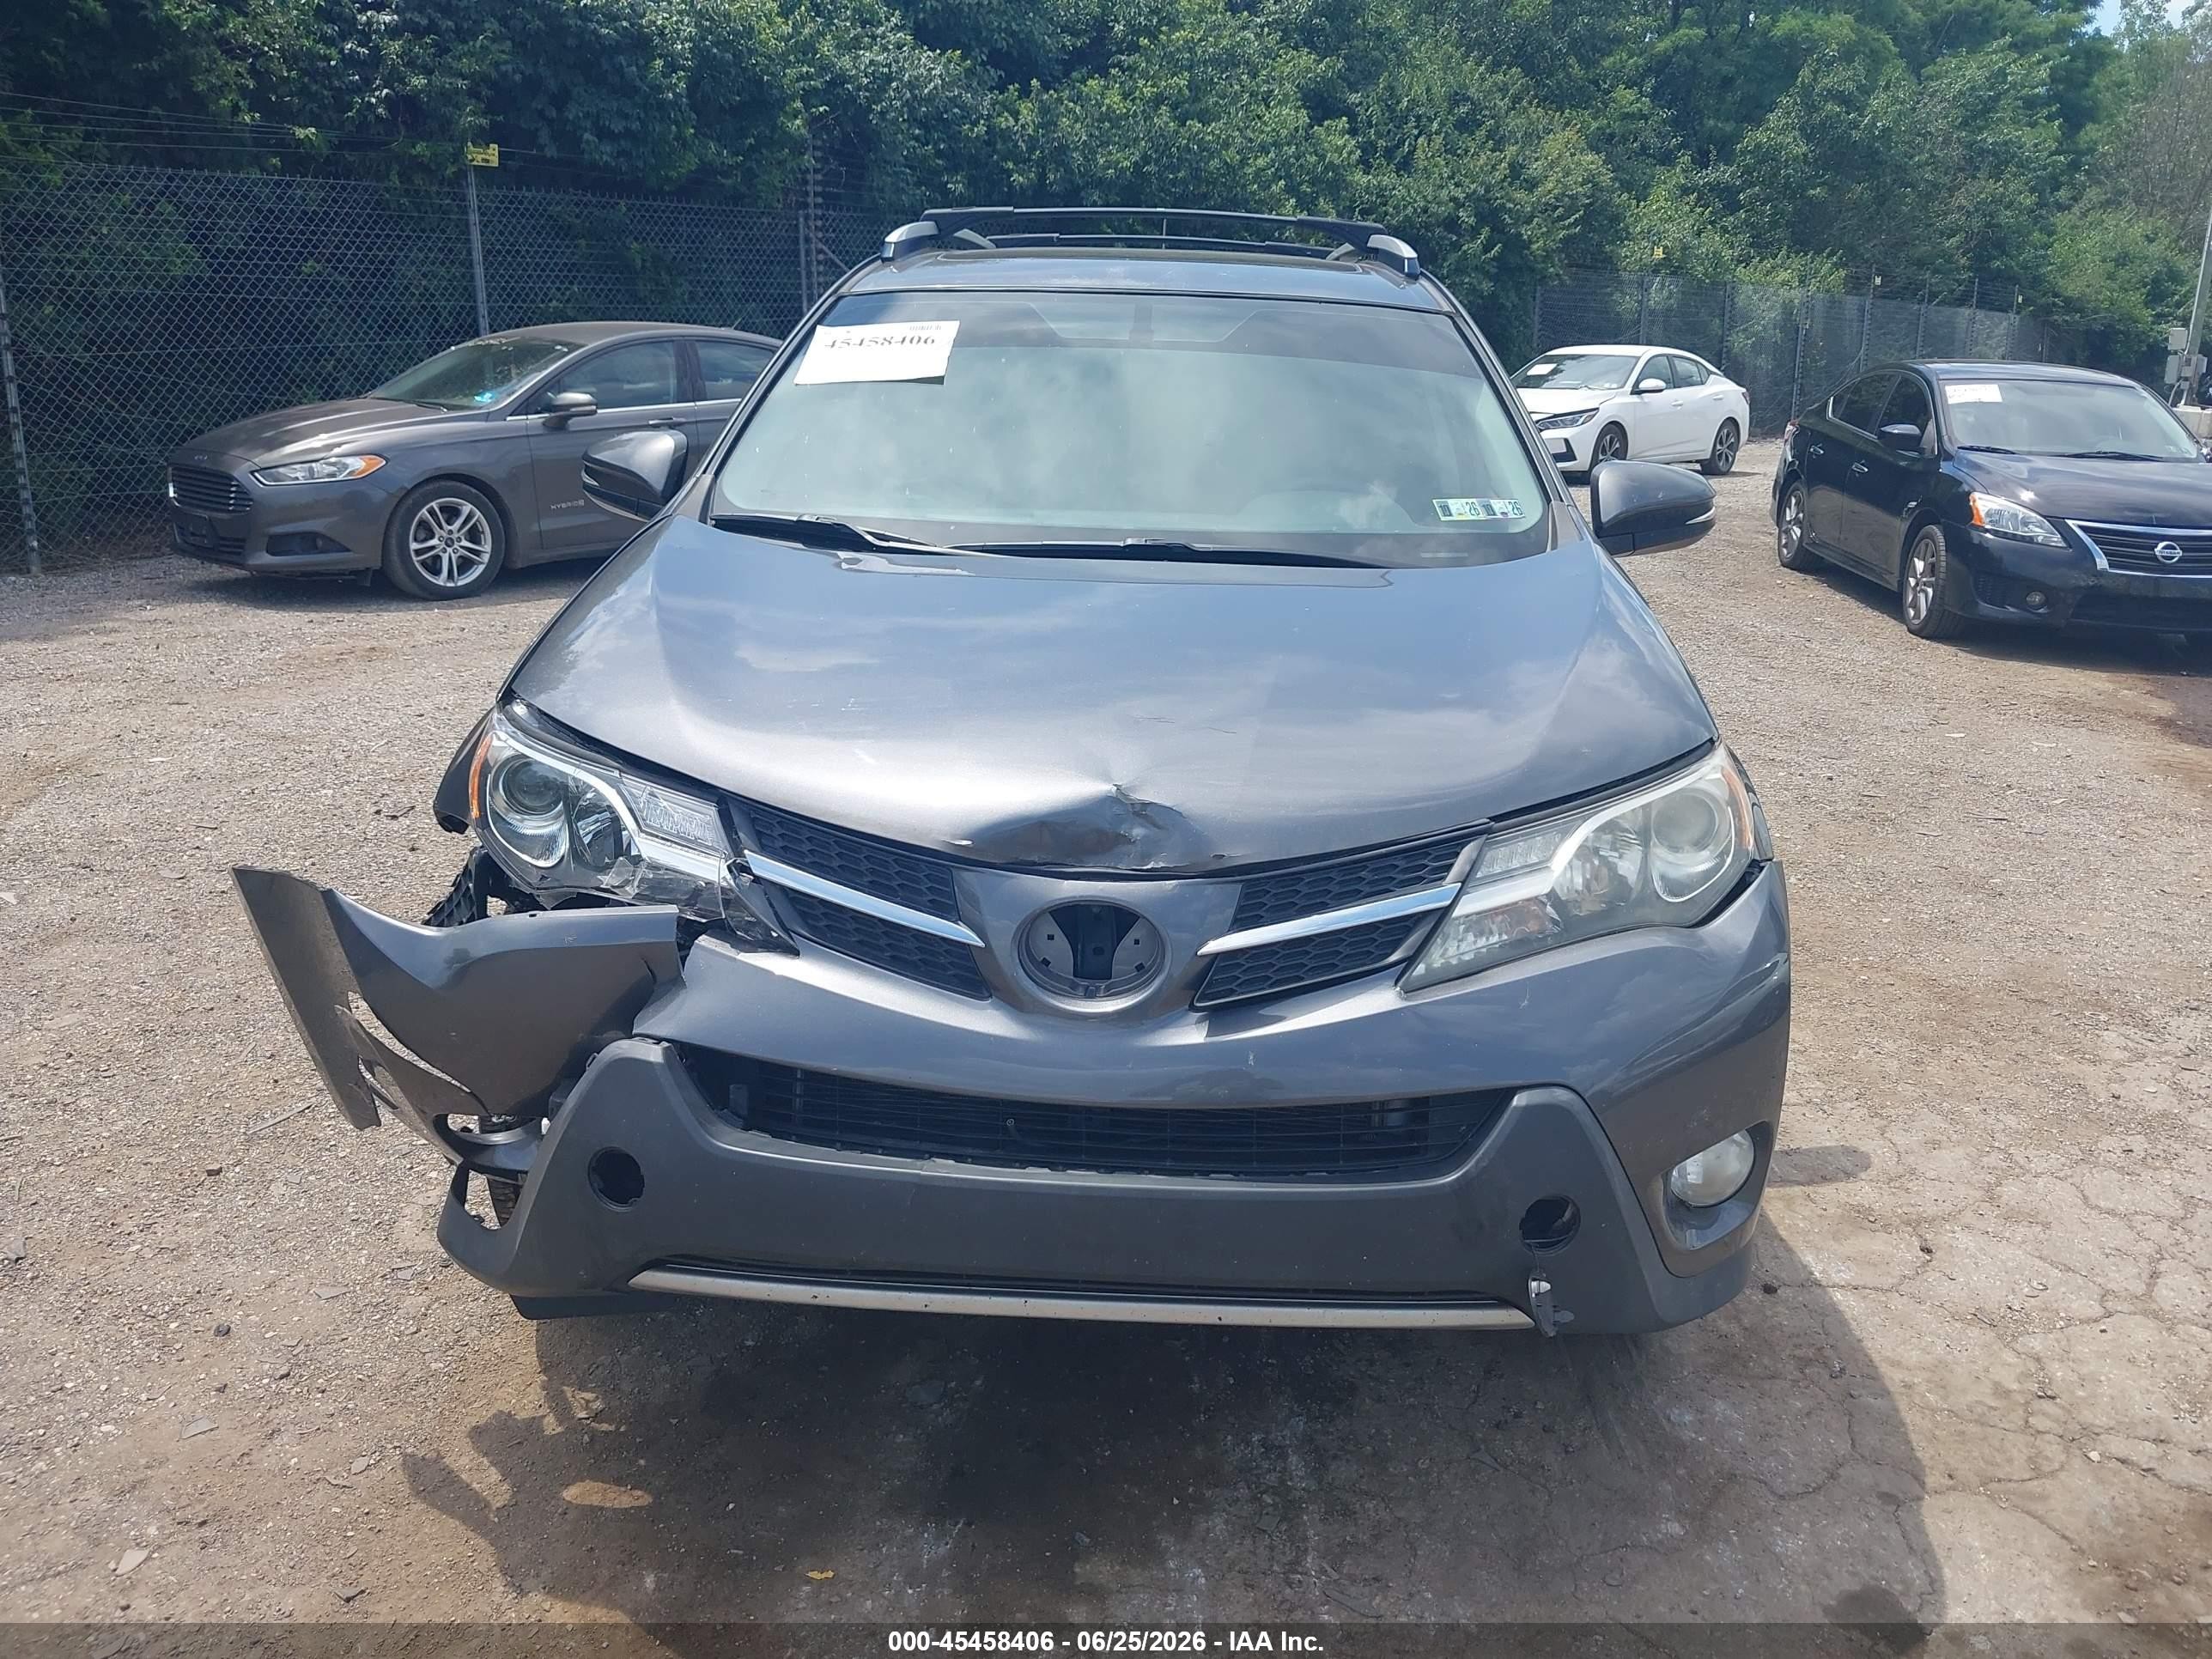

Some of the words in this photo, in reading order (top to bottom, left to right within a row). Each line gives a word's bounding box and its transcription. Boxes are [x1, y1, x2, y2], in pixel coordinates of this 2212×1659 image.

[824, 335, 935, 349] 45458406
[1466, 501, 1480, 516] 26
[1508, 501, 1523, 516] 26
